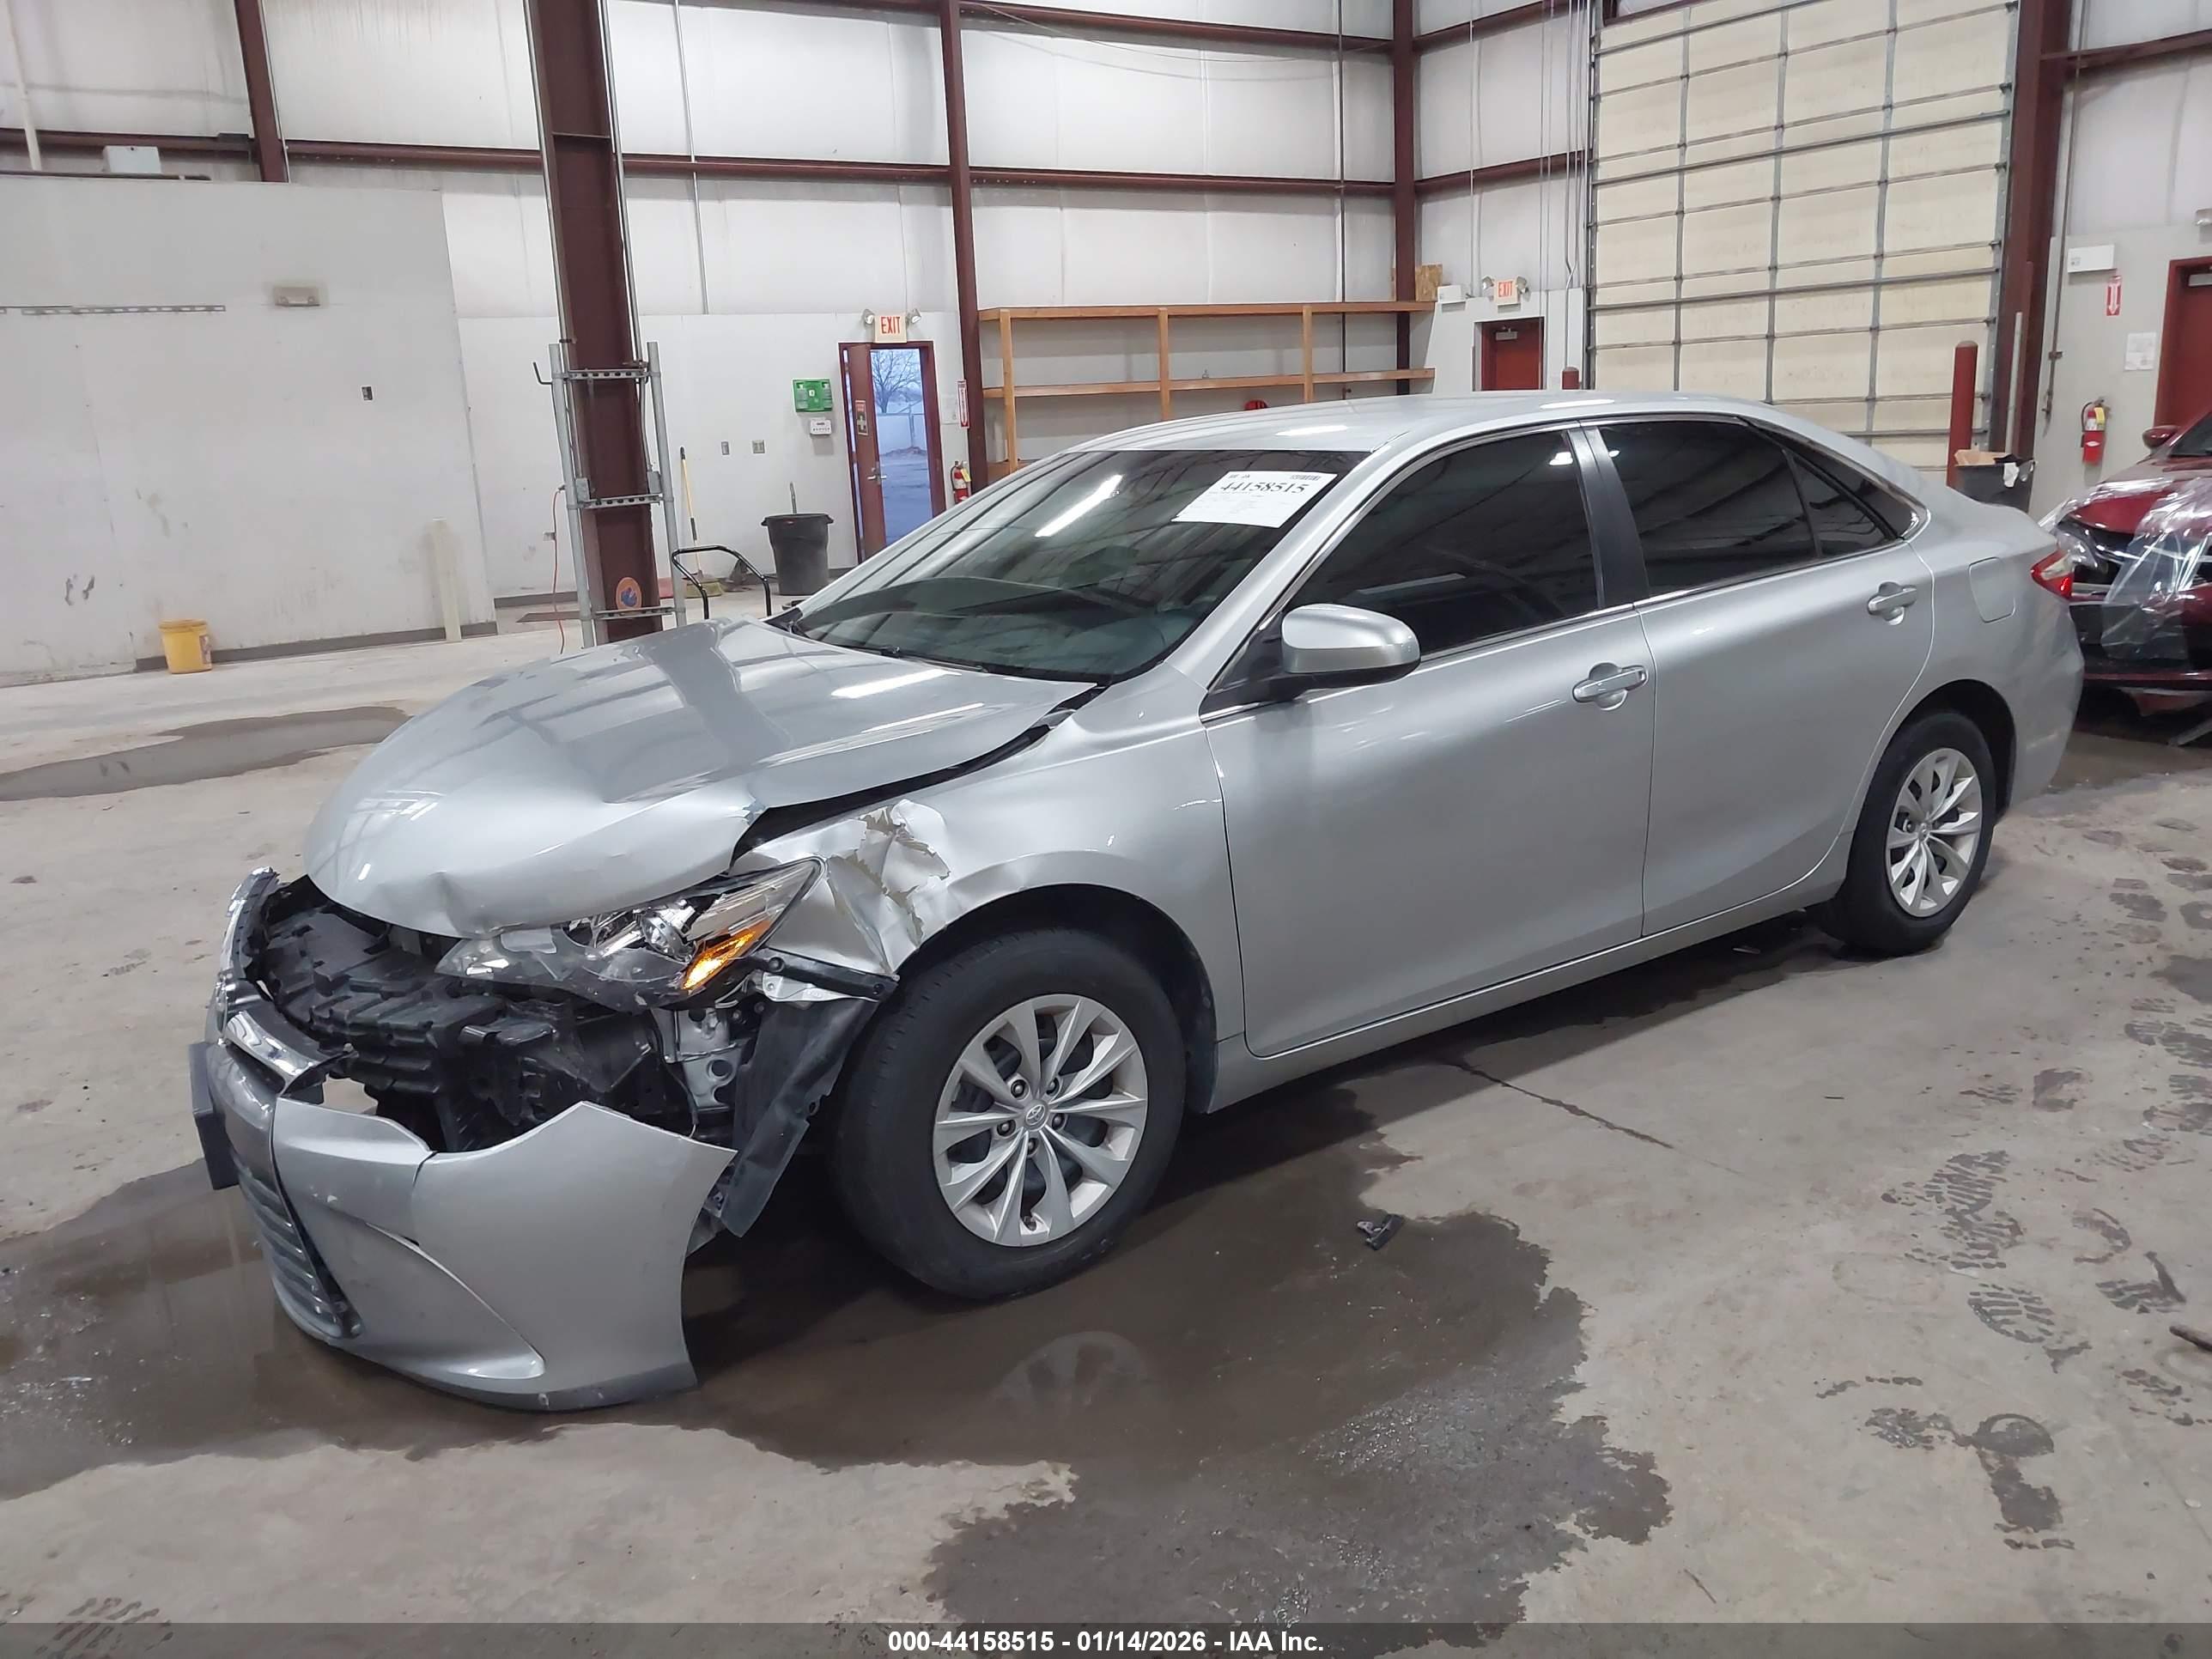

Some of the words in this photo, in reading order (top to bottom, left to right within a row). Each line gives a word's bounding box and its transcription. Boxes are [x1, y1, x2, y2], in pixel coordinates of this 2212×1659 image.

[1498, 281, 1513, 297] EXIT
[880, 316, 901, 334] EXIT
[1220, 482, 1310, 494] 44158515
